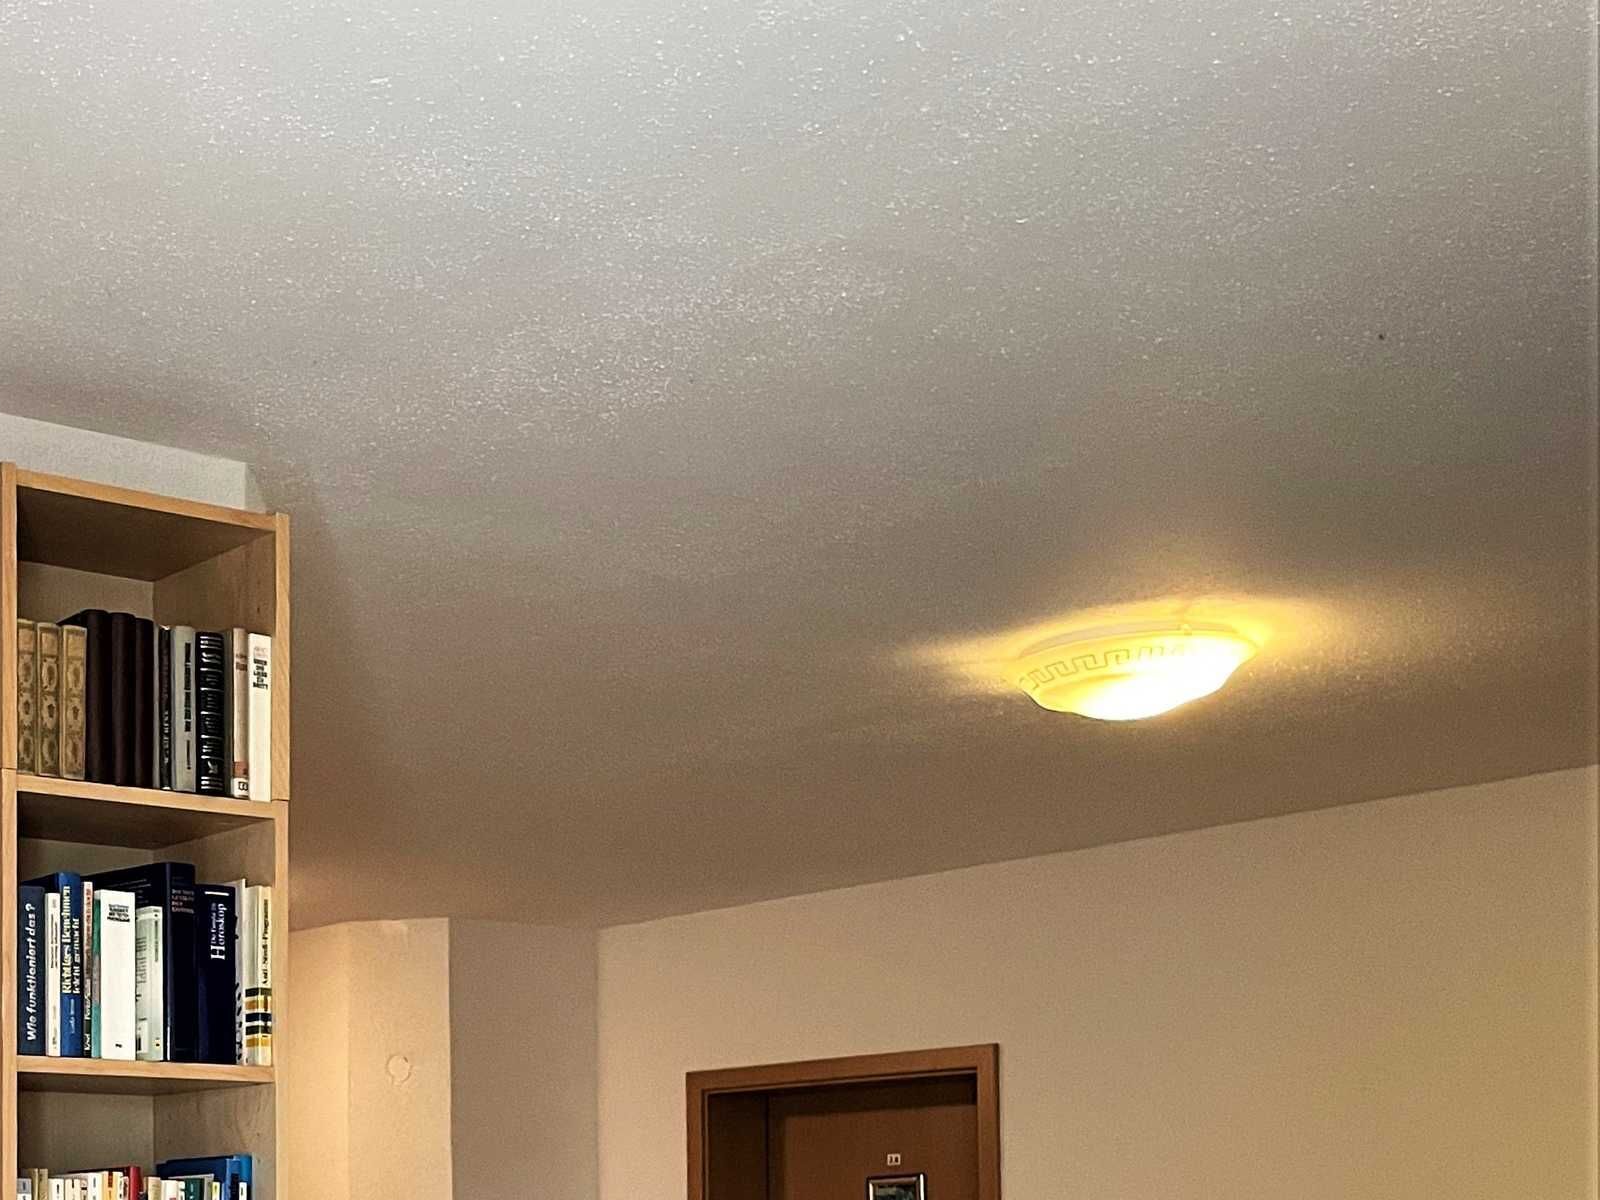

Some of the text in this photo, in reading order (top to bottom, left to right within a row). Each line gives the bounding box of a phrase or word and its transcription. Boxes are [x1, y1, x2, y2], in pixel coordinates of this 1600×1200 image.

[61, 886, 73, 994] Richtiges Benehmen
[209, 903, 228, 961] Horoskop
[25, 937, 38, 1041] Wie funktioniert
